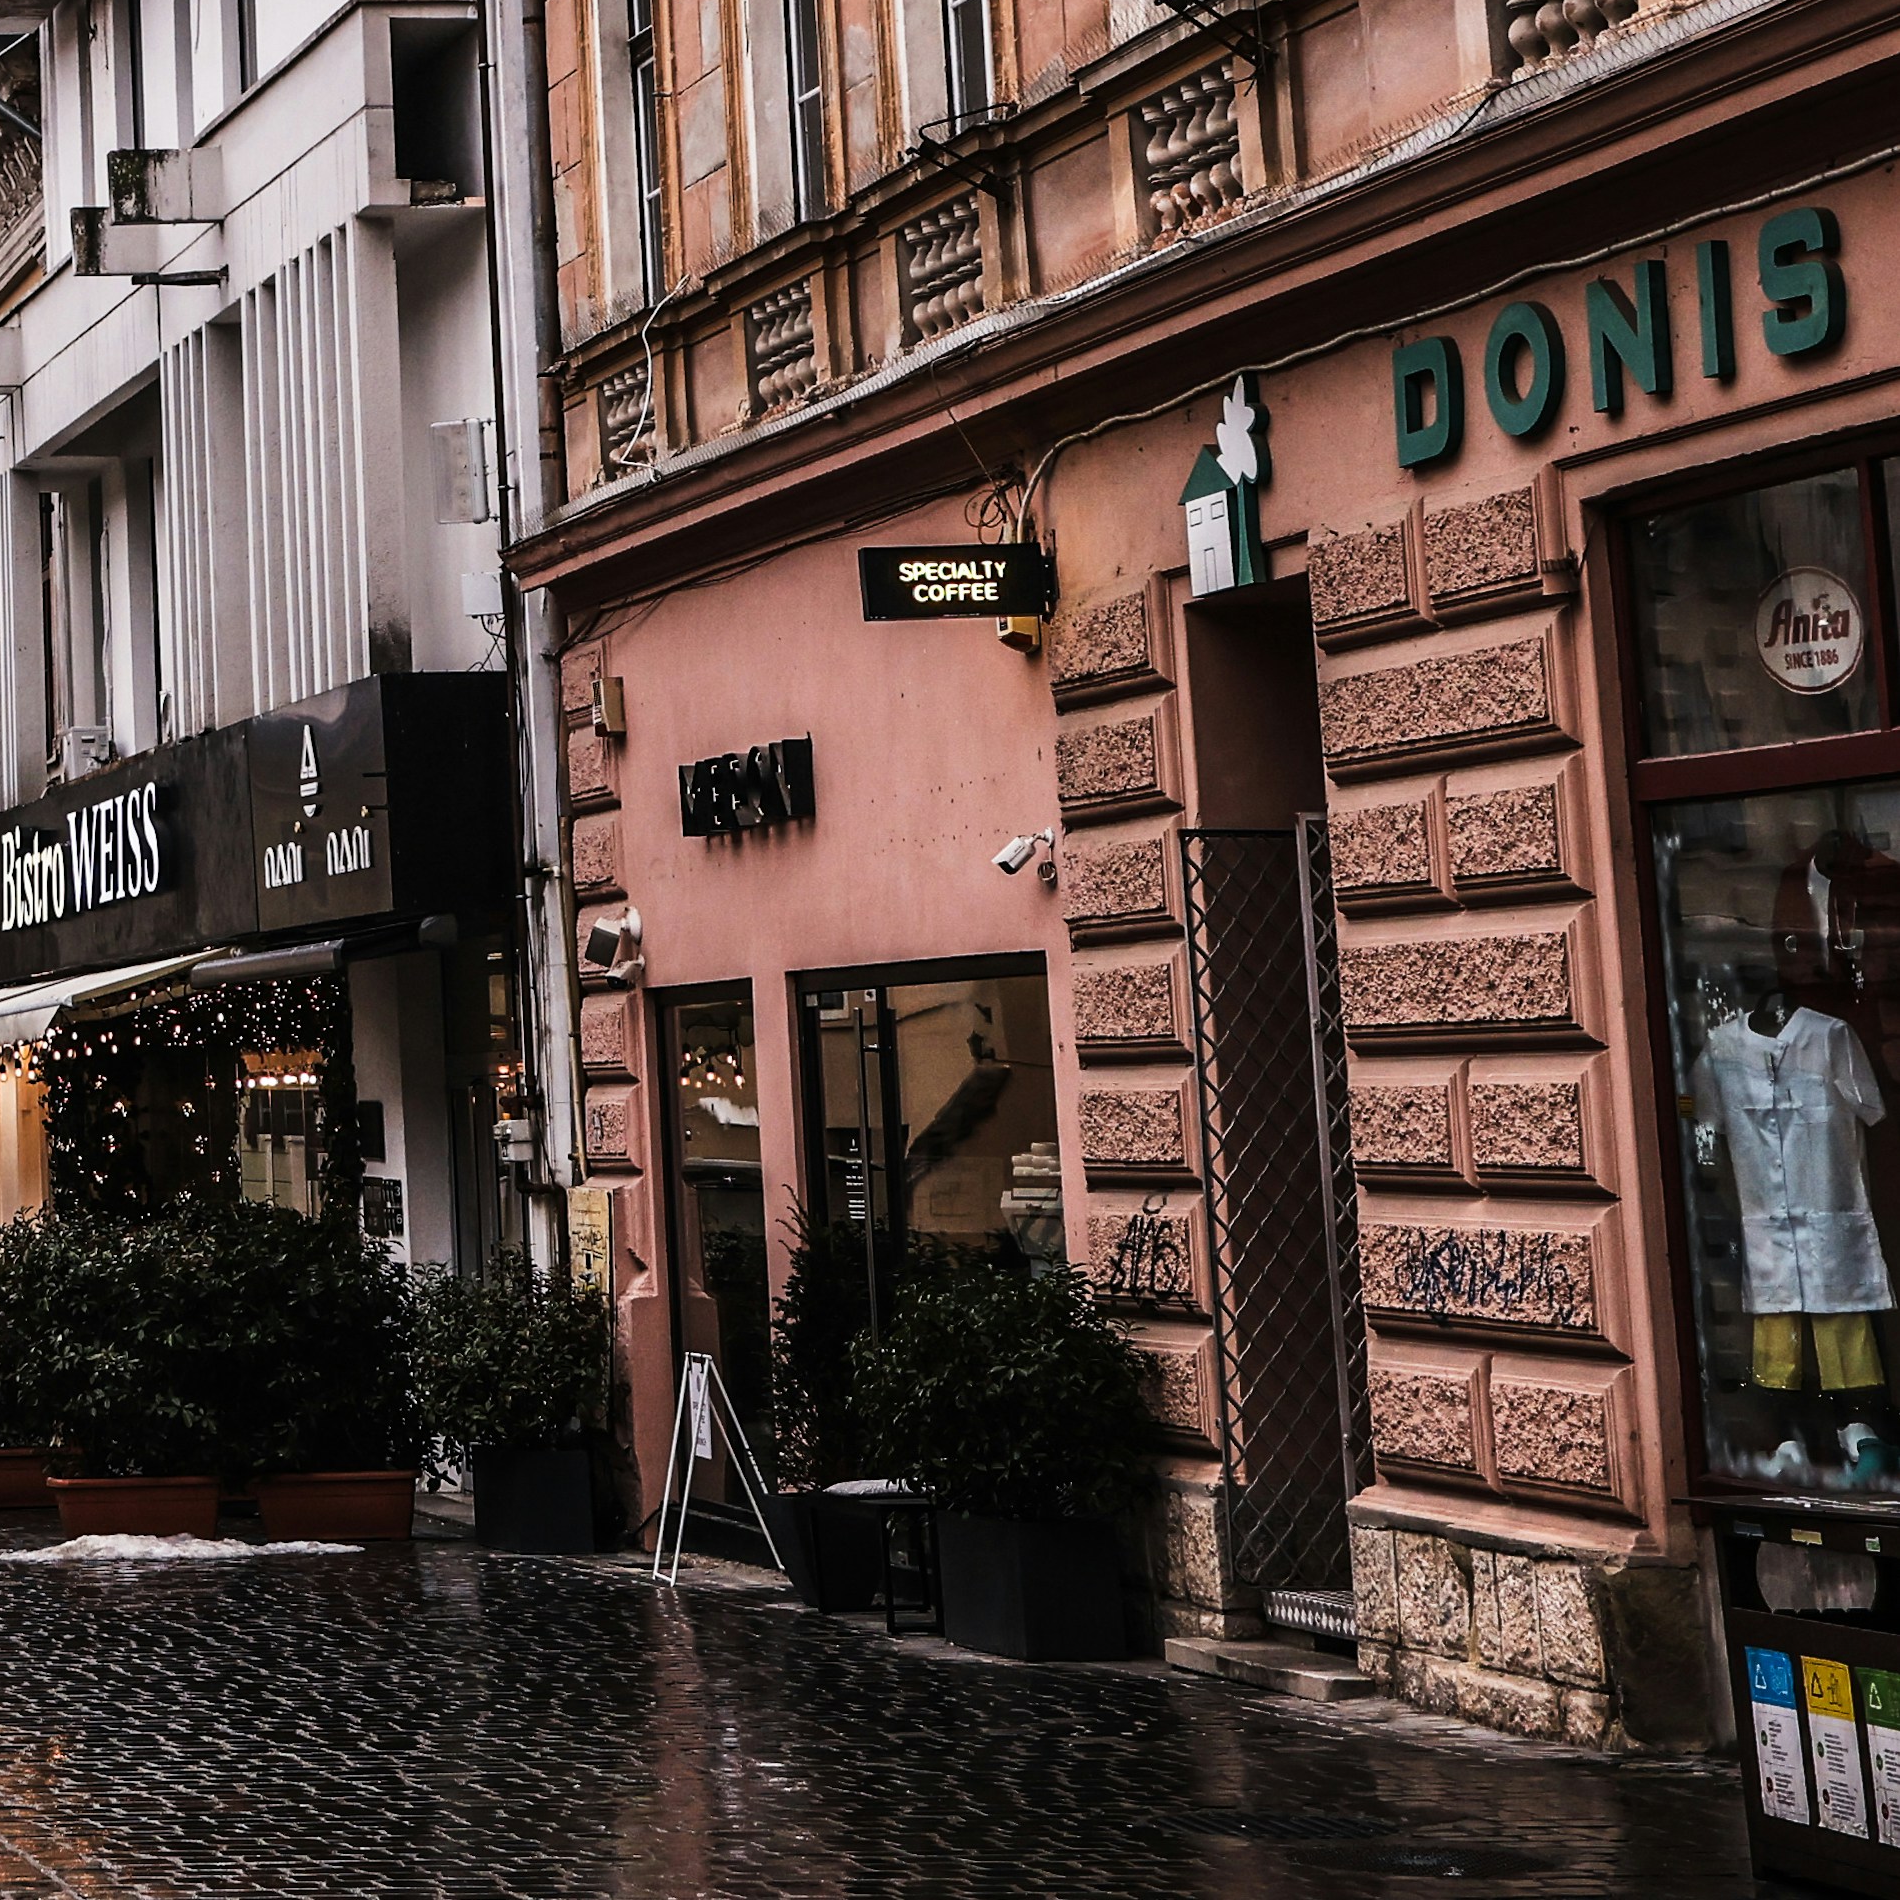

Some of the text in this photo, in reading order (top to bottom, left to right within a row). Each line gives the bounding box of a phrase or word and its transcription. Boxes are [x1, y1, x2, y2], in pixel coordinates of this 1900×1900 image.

[1392, 207, 1847, 469] DONIS
[898, 560, 1007, 582] SPECIALTY
[912, 582, 1000, 603] COFFEE
[1784, 649, 1839, 670] SINCE 1886
[1, 782, 160, 931] Bistro WEISS
[393, 1185, 401, 1197] 3
